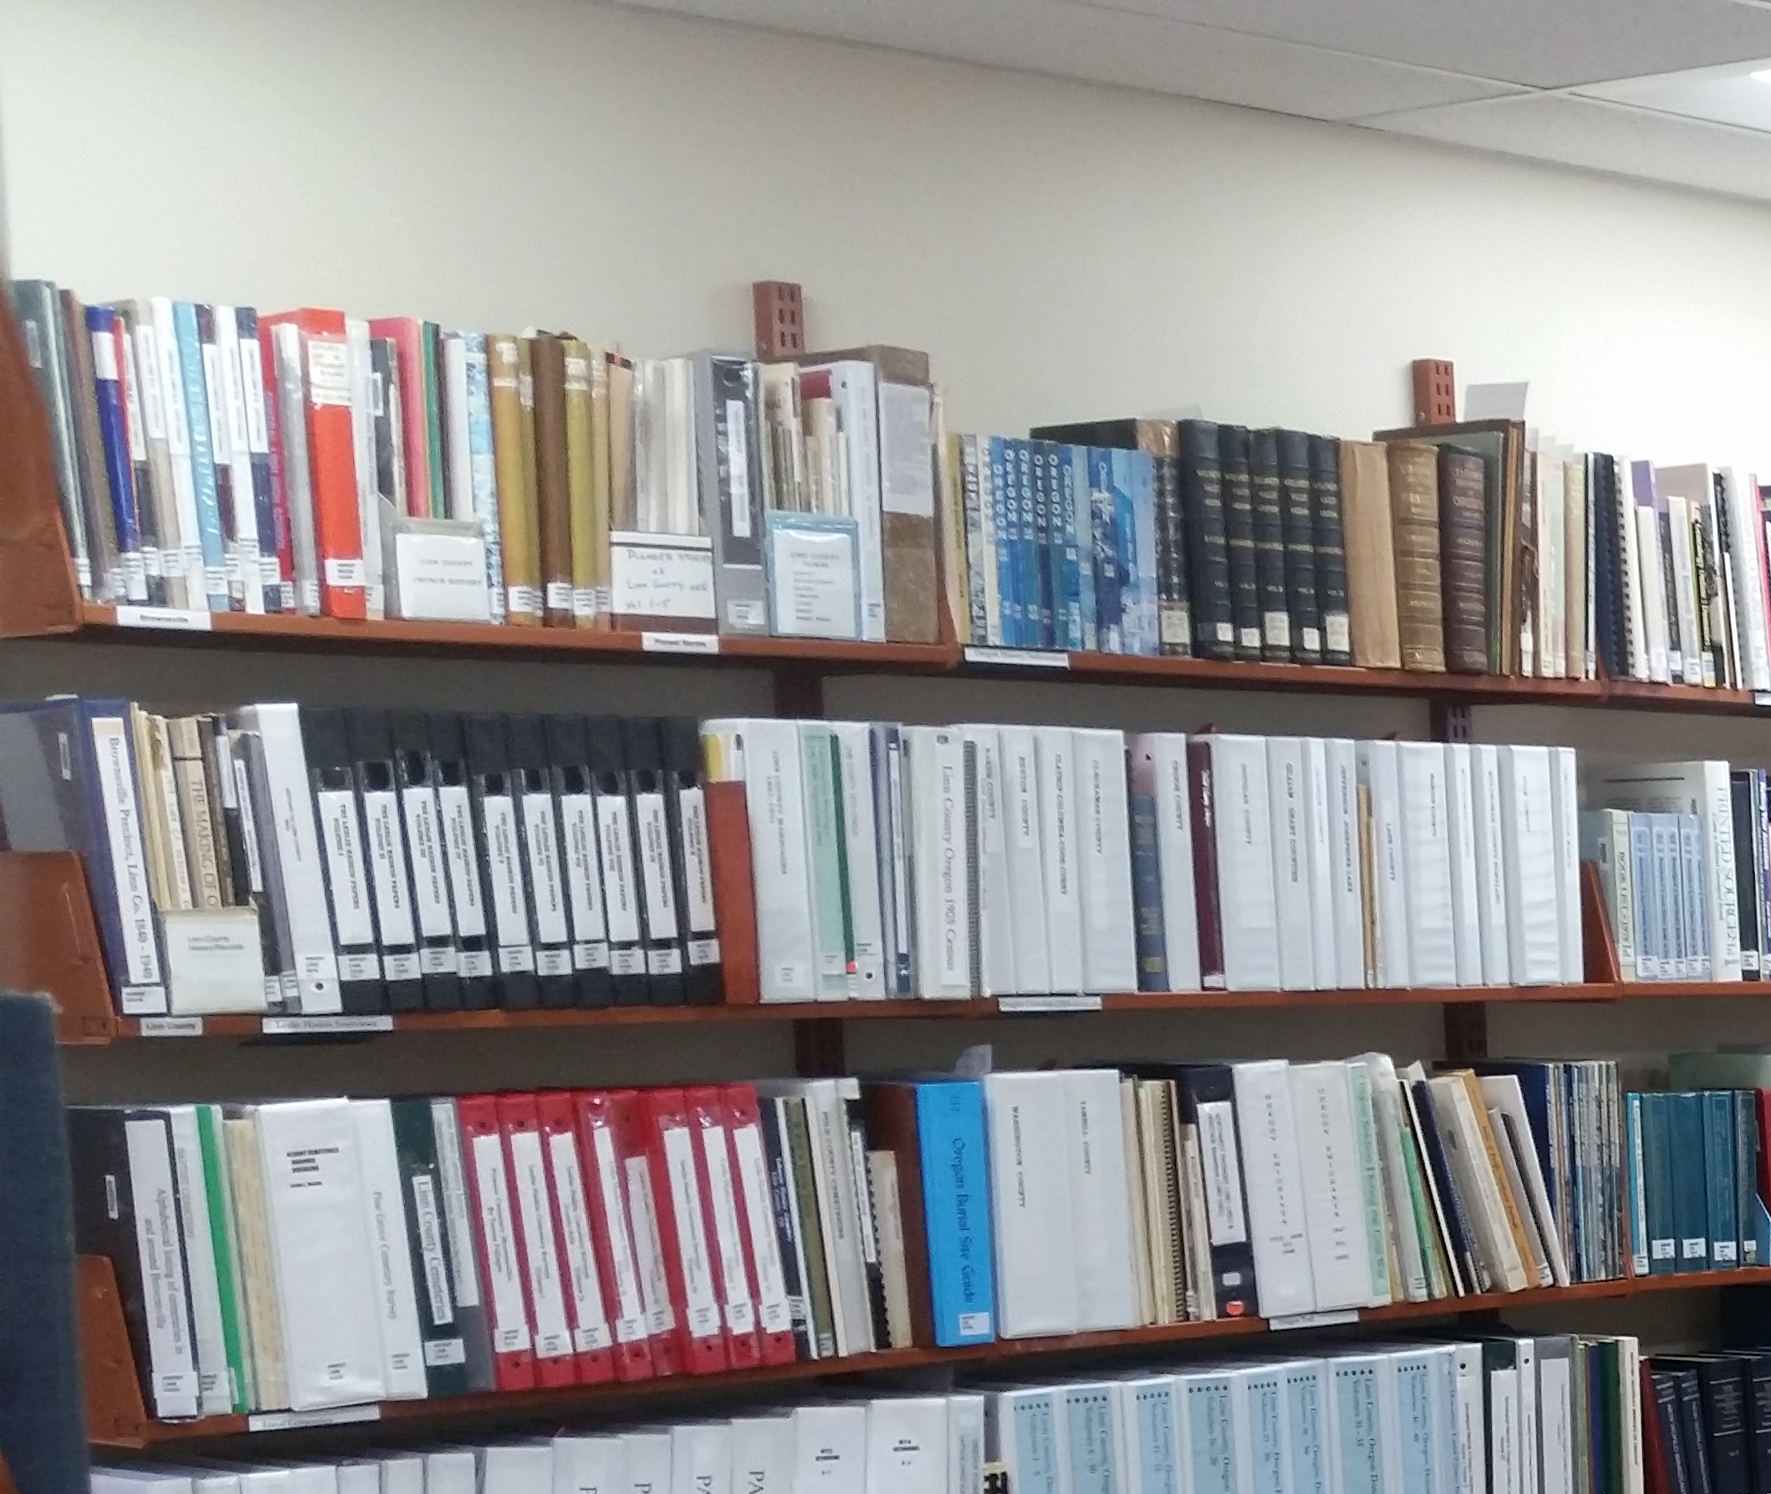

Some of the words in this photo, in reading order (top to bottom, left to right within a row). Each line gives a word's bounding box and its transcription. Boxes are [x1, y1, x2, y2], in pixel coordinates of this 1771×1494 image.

[1004, 449, 1017, 522] OREGON
[1020, 450, 1032, 522] OREGON
[1035, 454, 1047, 527] OREGON
[1048, 454, 1061, 526] OREGON
